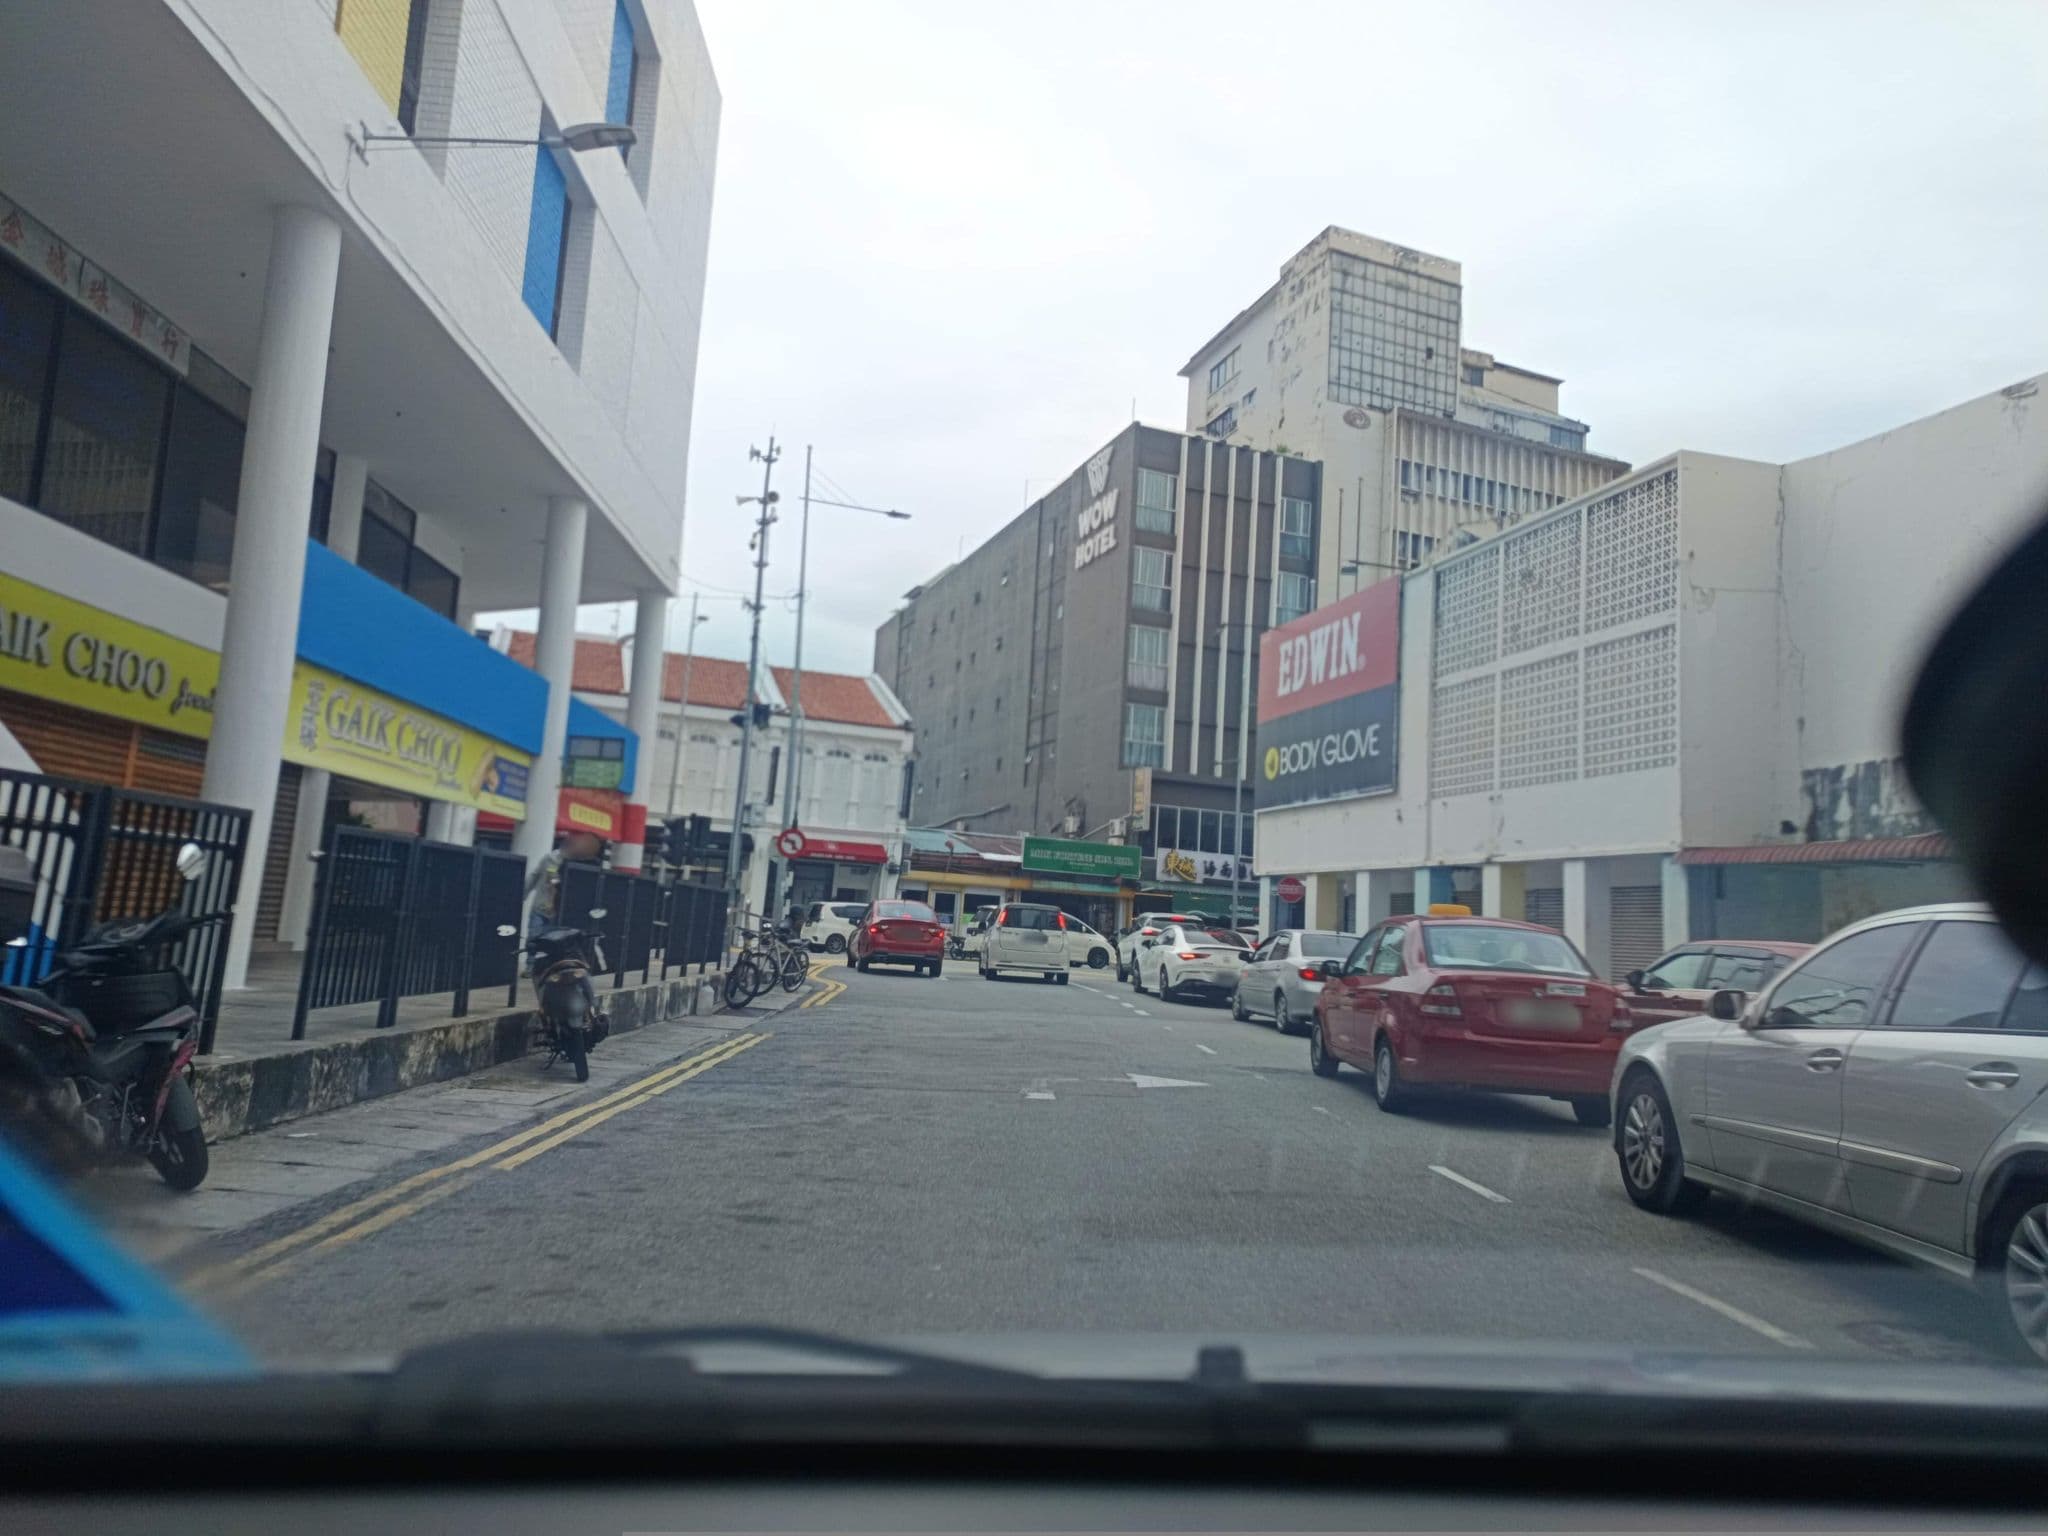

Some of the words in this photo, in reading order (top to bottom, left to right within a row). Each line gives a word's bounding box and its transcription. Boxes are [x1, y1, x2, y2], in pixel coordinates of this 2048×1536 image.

[1078, 488, 1119, 539] WOW
[1075, 523, 1117, 570] HOTEL
[63, 631, 171, 700] CHOO
[1277, 611, 1362, 697] EDWIN
[325, 686, 397, 755] GAIK
[396, 711, 462, 778] CHOO
[1279, 738, 1321, 776] BODY
[1321, 723, 1381, 767] GLOVE
